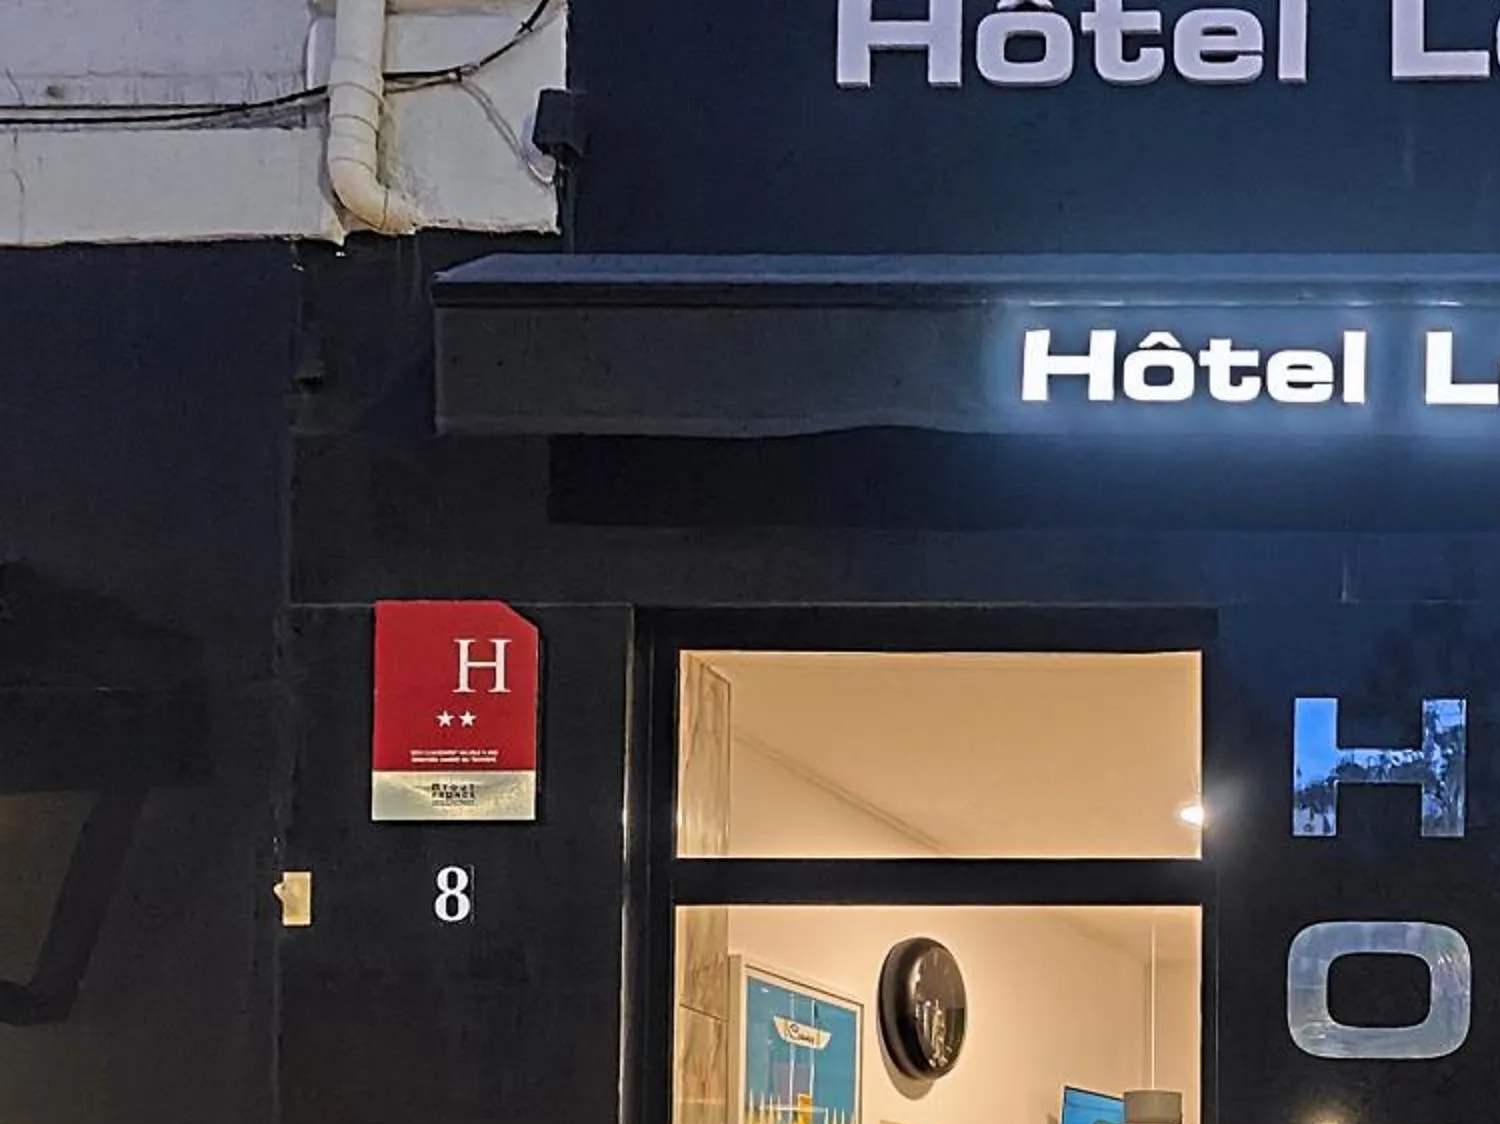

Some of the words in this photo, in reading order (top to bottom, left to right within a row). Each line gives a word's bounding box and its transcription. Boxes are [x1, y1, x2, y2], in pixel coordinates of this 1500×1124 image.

[836, 0, 1307, 87] Hôtel
[1022, 331, 1366, 403] Hôtel
[453, 639, 511, 693] H
[434, 866, 472, 922] 8
